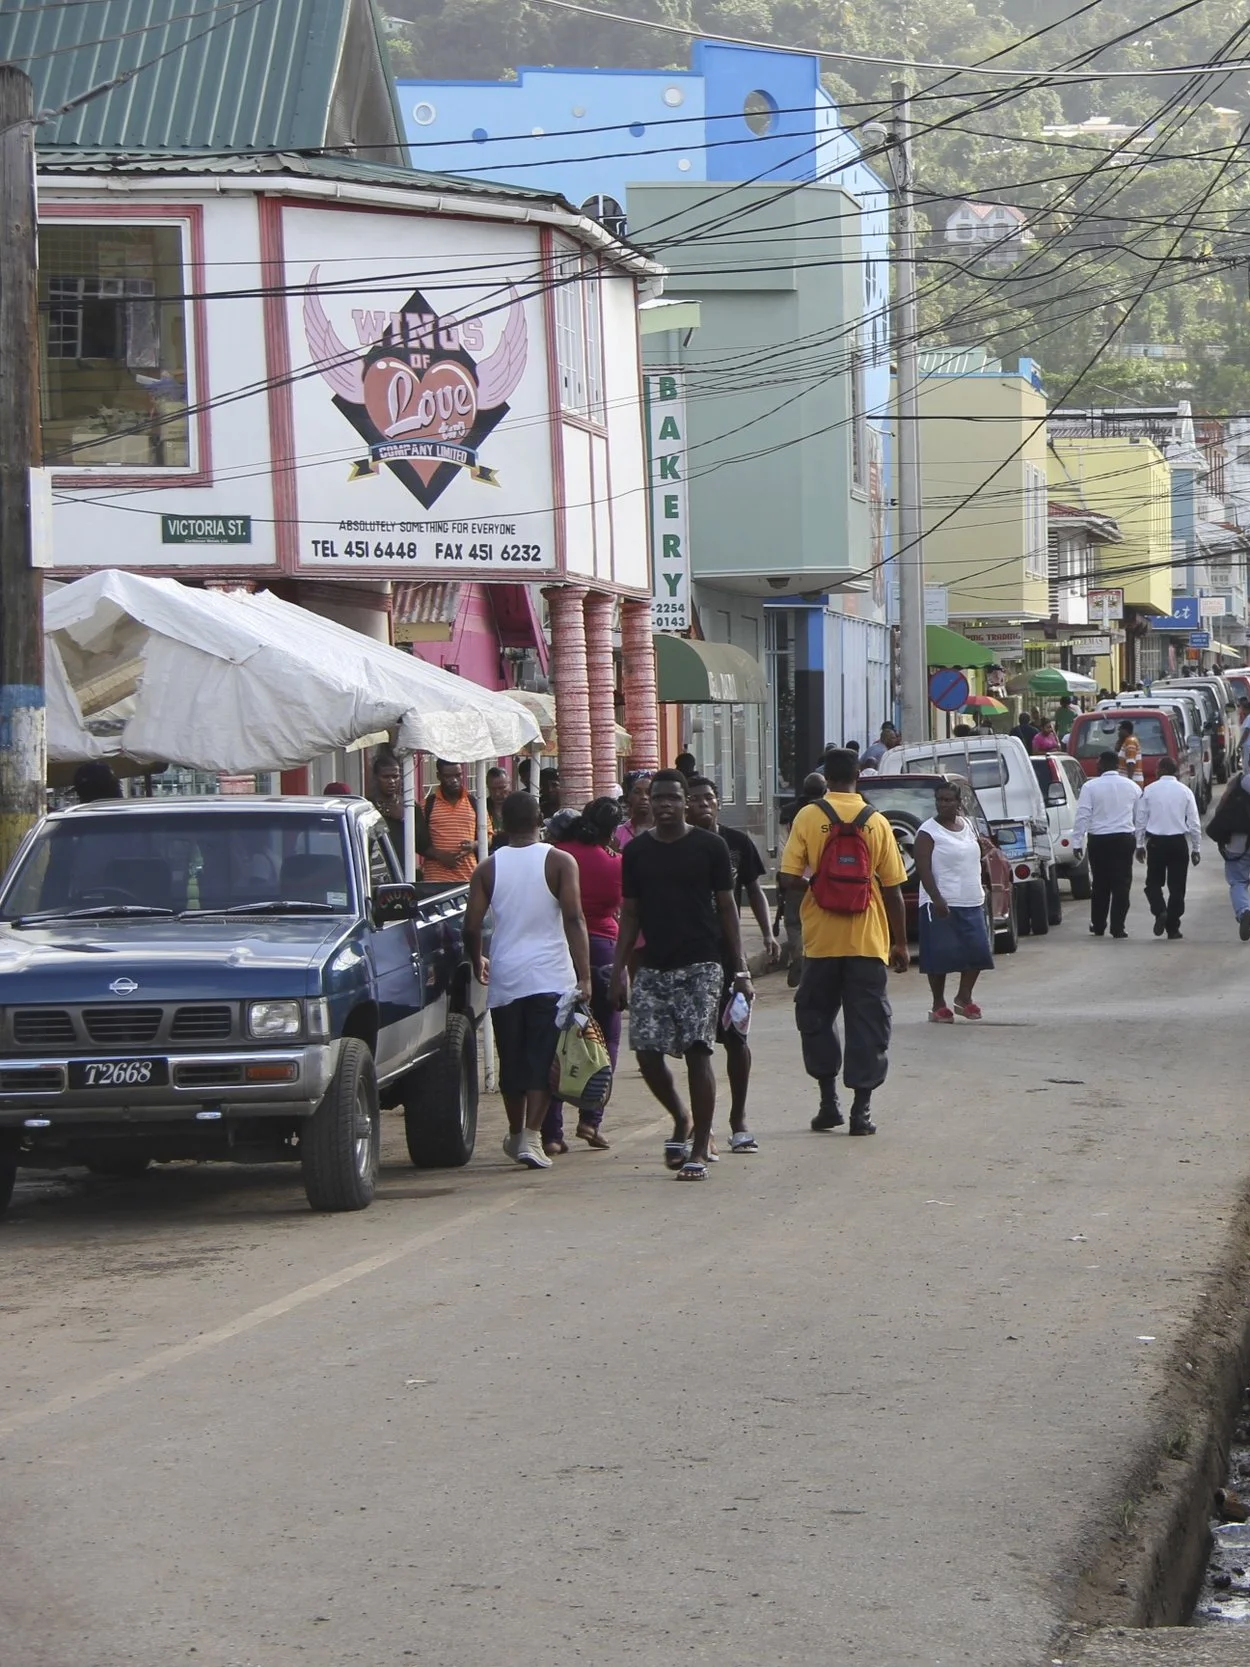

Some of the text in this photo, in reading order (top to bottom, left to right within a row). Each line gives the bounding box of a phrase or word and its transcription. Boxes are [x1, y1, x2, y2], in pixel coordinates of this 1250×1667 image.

[352, 309, 485, 352] WINGS
[409, 353, 431, 369] OF
[385, 371, 472, 438] Love
[379, 445, 468, 464] COMPANY LIMITED
[658, 376, 684, 597] BAKERY
[168, 520, 246, 536] VICTORIA ST.
[338, 520, 516, 535] ABSOLUTELY SOMETHING FOR EVERYONE
[311, 540, 542, 562] TEL 451 6448 FAX 451 6232
[987, 632, 1022, 641] TRADING
[820, 823, 875, 834] SETY
[84, 1061, 153, 1085] T2668
